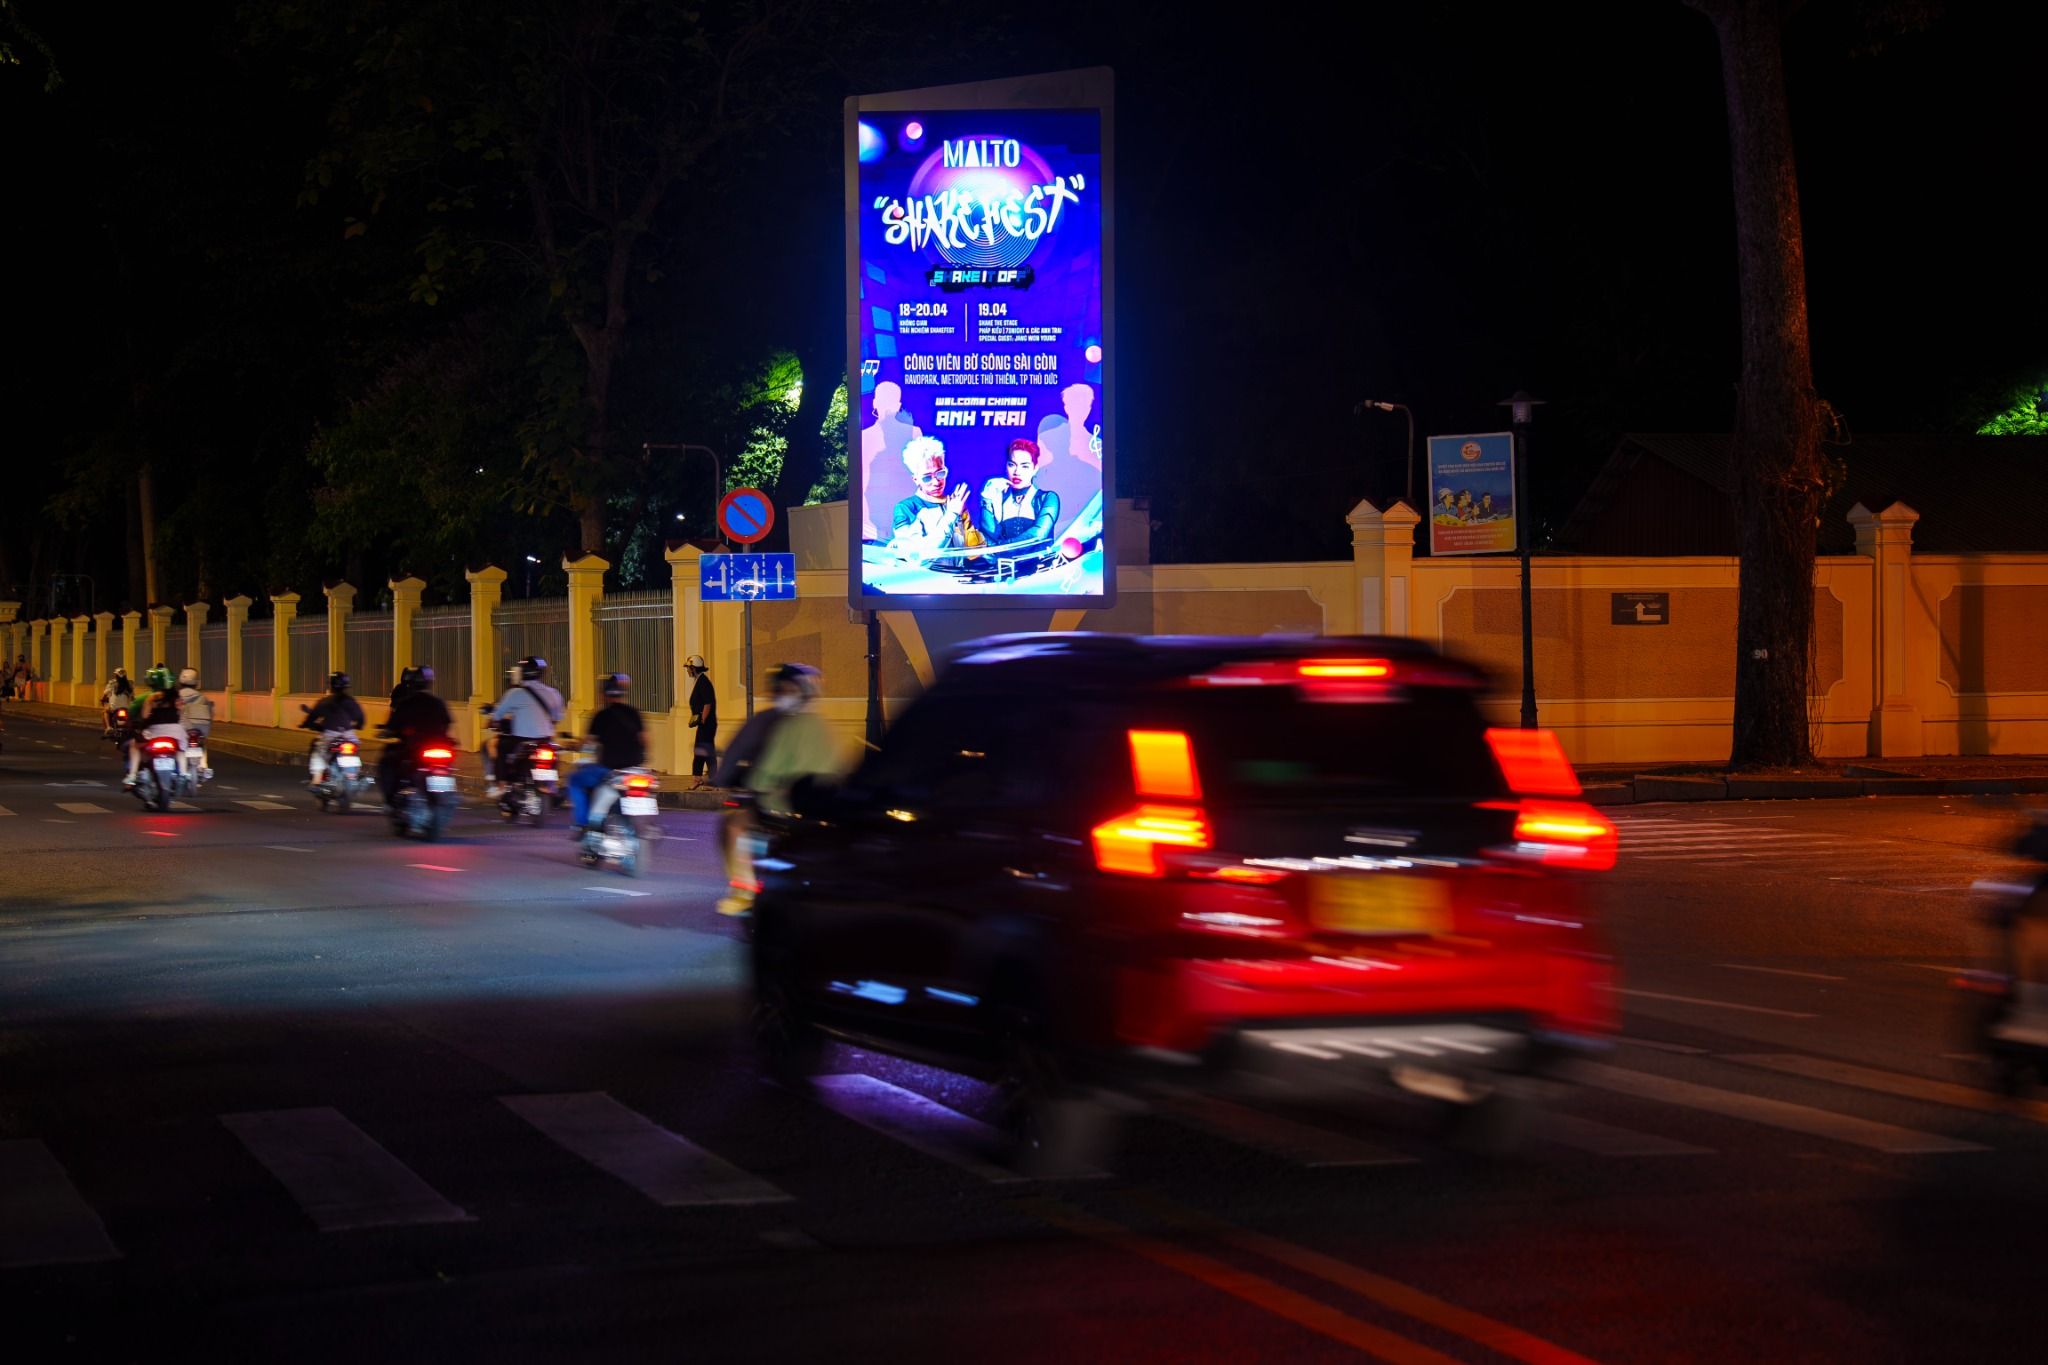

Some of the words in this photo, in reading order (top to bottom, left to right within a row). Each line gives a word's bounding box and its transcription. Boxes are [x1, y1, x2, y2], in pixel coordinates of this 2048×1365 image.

[943, 139, 1020, 168] MALTO
[898, 303, 948, 316] 18-20.04
[978, 303, 1007, 316] 19.04
[904, 353, 934, 370] CÔNG
[936, 353, 961, 370] VIÊN
[963, 353, 979, 370] BỜ
[981, 353, 1011, 370] SÔNG
[1013, 353, 1031, 370] SÀI
[1034, 353, 1057, 370] GÒN
[941, 374, 979, 385] METROPOLE
[981, 373, 994, 385] THỦ
[1019, 374, 1028, 385] TP
[1029, 373, 1042, 385] THỦ
[935, 410, 977, 427] ANH
[981, 410, 1027, 427] TRAI
